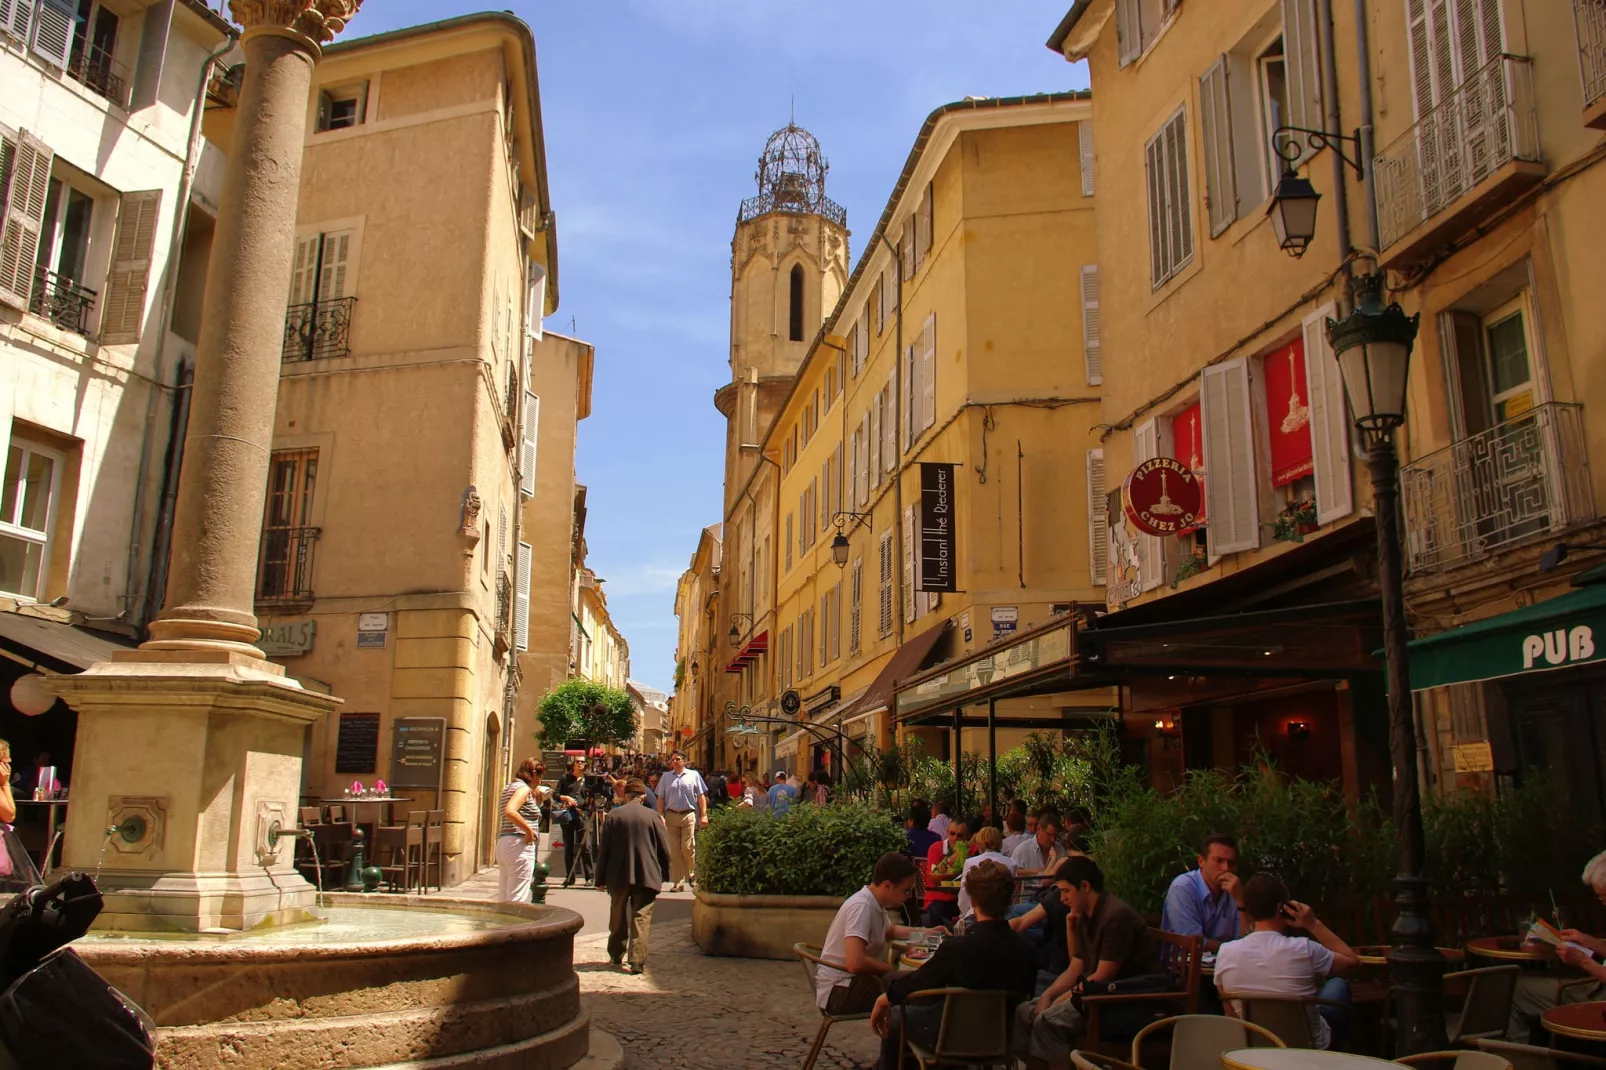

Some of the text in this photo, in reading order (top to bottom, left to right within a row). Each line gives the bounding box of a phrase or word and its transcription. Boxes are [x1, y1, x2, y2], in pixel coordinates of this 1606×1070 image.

[1136, 459, 1192, 483] PIZZERIA
[922, 468, 948, 587] L'instant thé Riederer
[1140, 511, 1175, 531] CHEZ
[1180, 512, 1194, 528] JO
[1522, 624, 1595, 669] PUB
